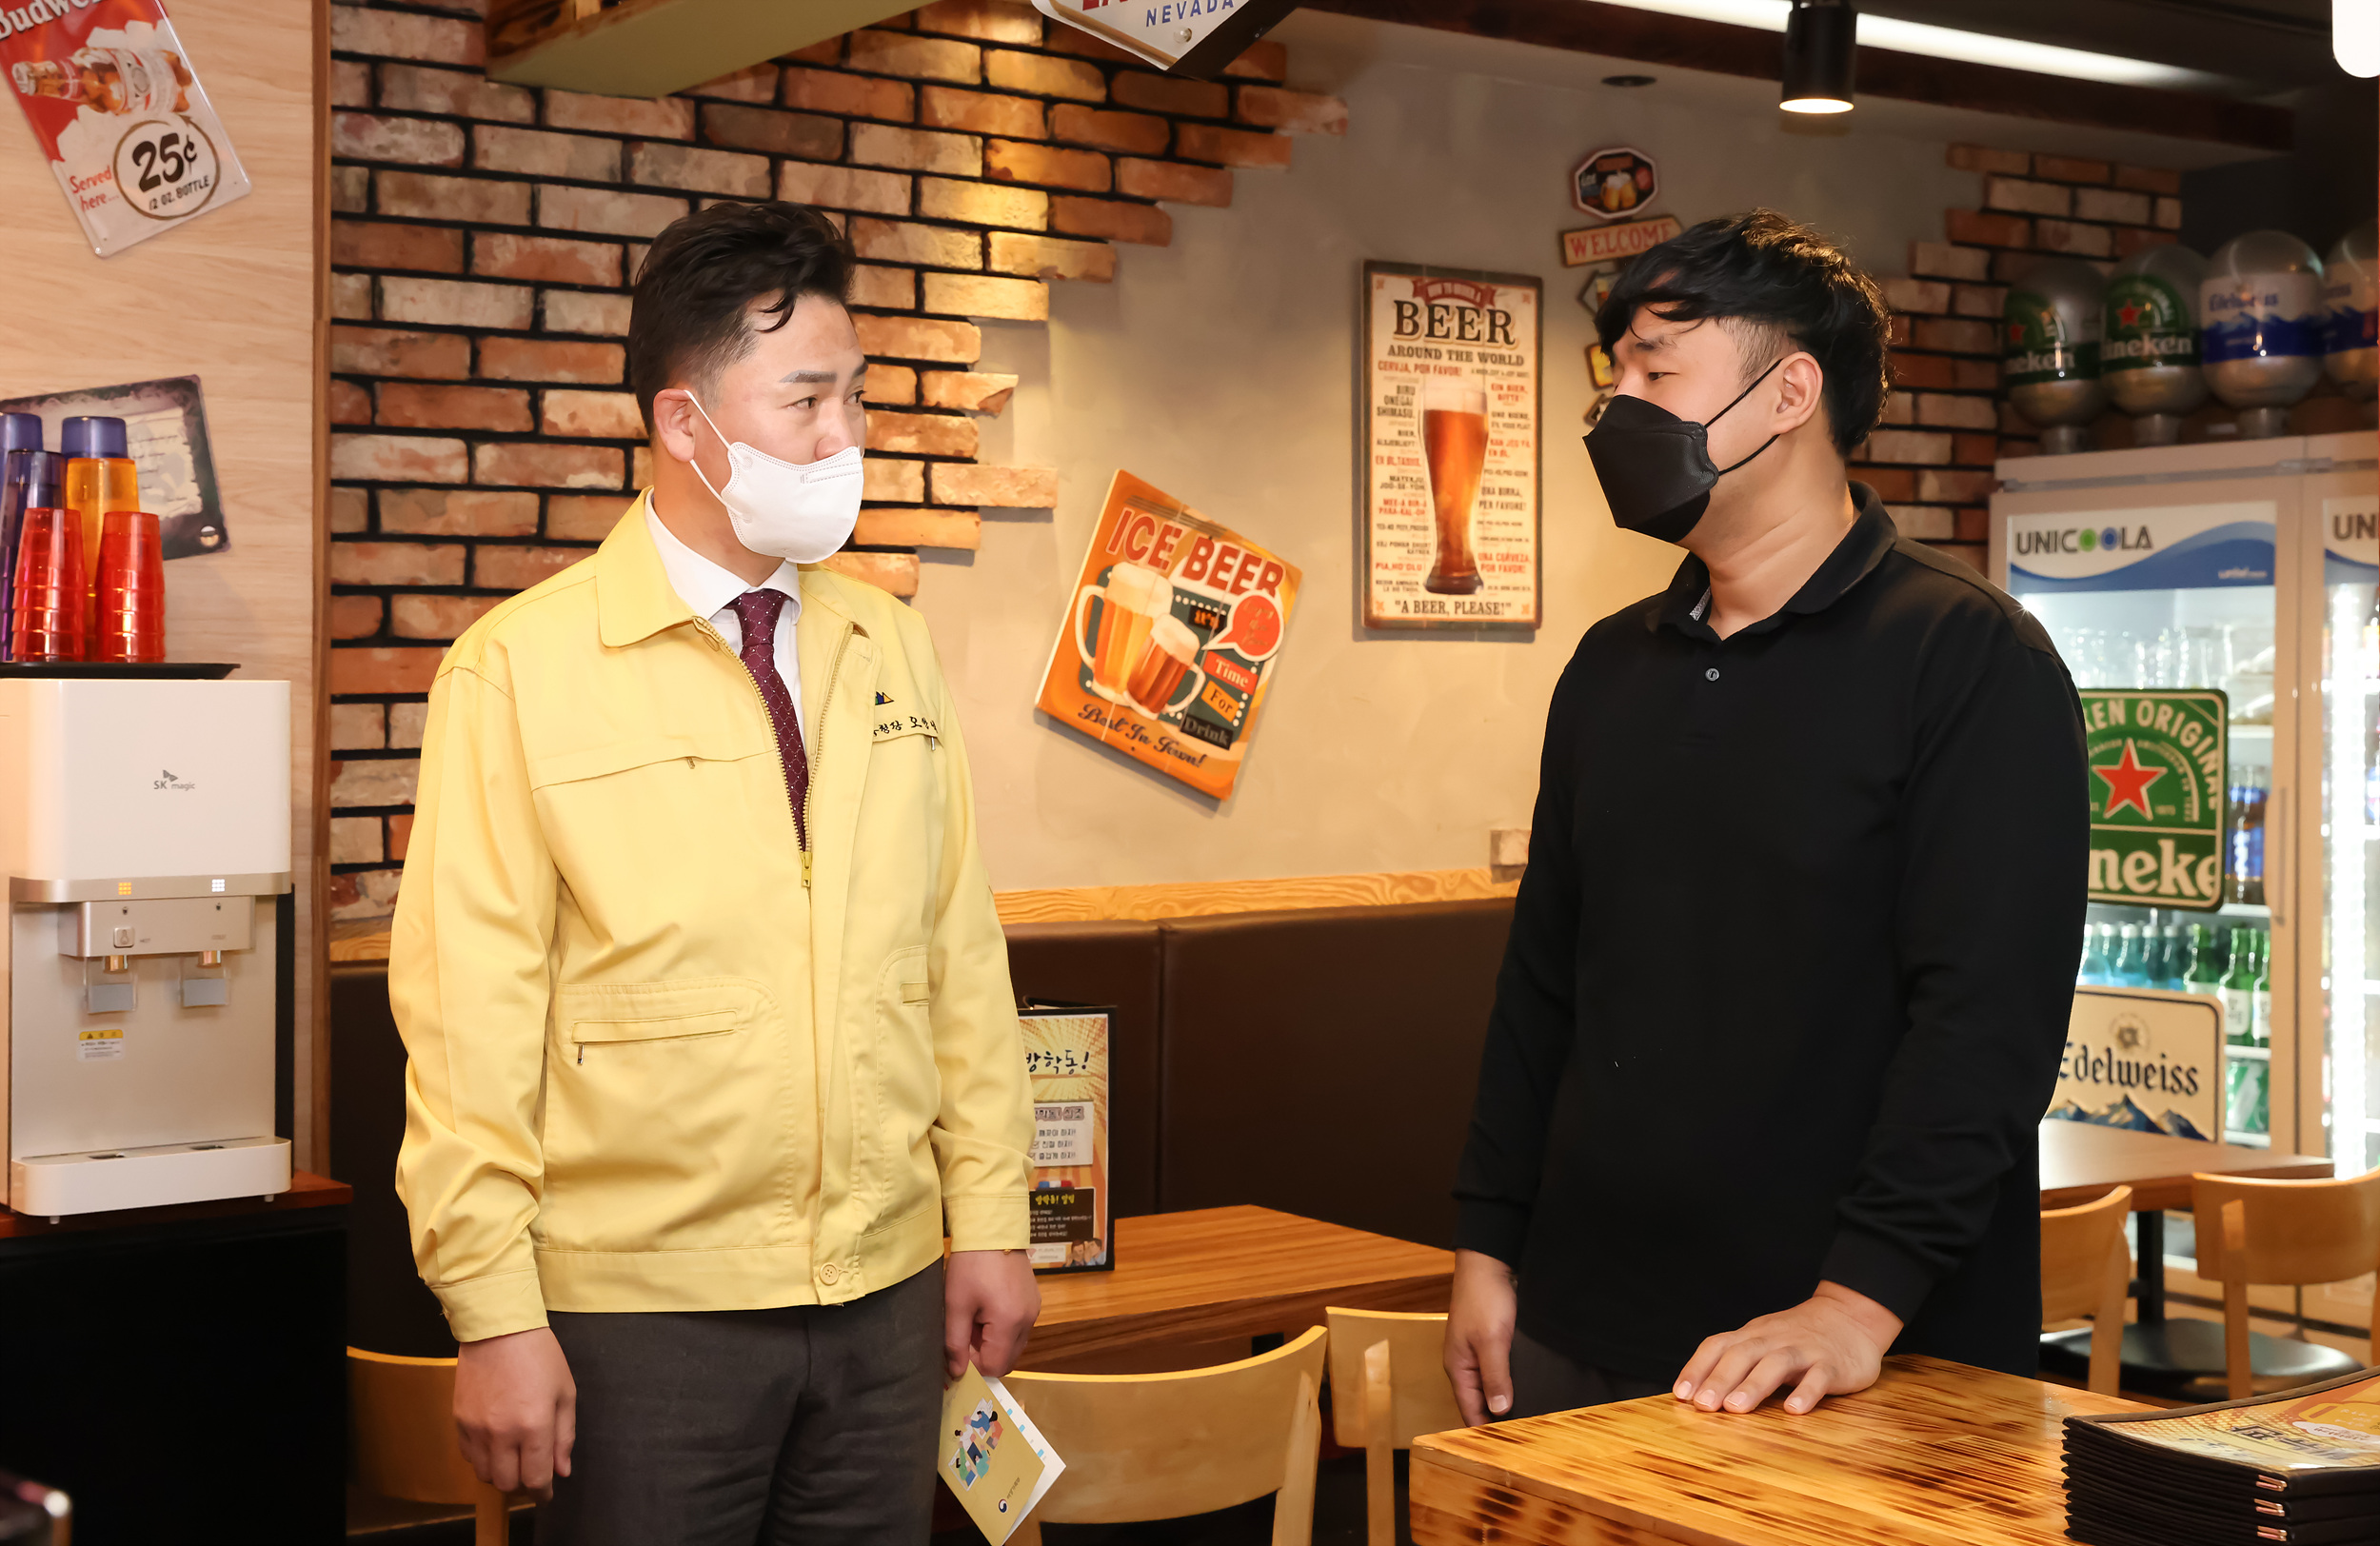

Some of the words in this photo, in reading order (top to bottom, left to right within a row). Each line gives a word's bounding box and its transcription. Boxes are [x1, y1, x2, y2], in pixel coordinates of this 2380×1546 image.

[1145, 0, 1235, 27] NEVADA
[69, 165, 112, 193] Served
[149, 197, 159, 210] 12
[175, 175, 210, 199] BOTTLE
[1570, 222, 1672, 258] WELCOME
[1393, 300, 1517, 345] BEER
[1387, 345, 1442, 361] AROUND
[1446, 349, 1474, 363] THE
[1478, 351, 1525, 367] WORLD
[1106, 508, 1182, 569] ICE
[1182, 536, 1284, 598] BEER
[1413, 600, 1450, 616] BEER,
[1215, 658, 1249, 688] Time
[1209, 687, 1233, 714] For
[1078, 704, 1129, 733] Best
[1184, 717, 1229, 743] Drink
[154, 780, 168, 789] SK
[171, 782, 196, 791] magic
